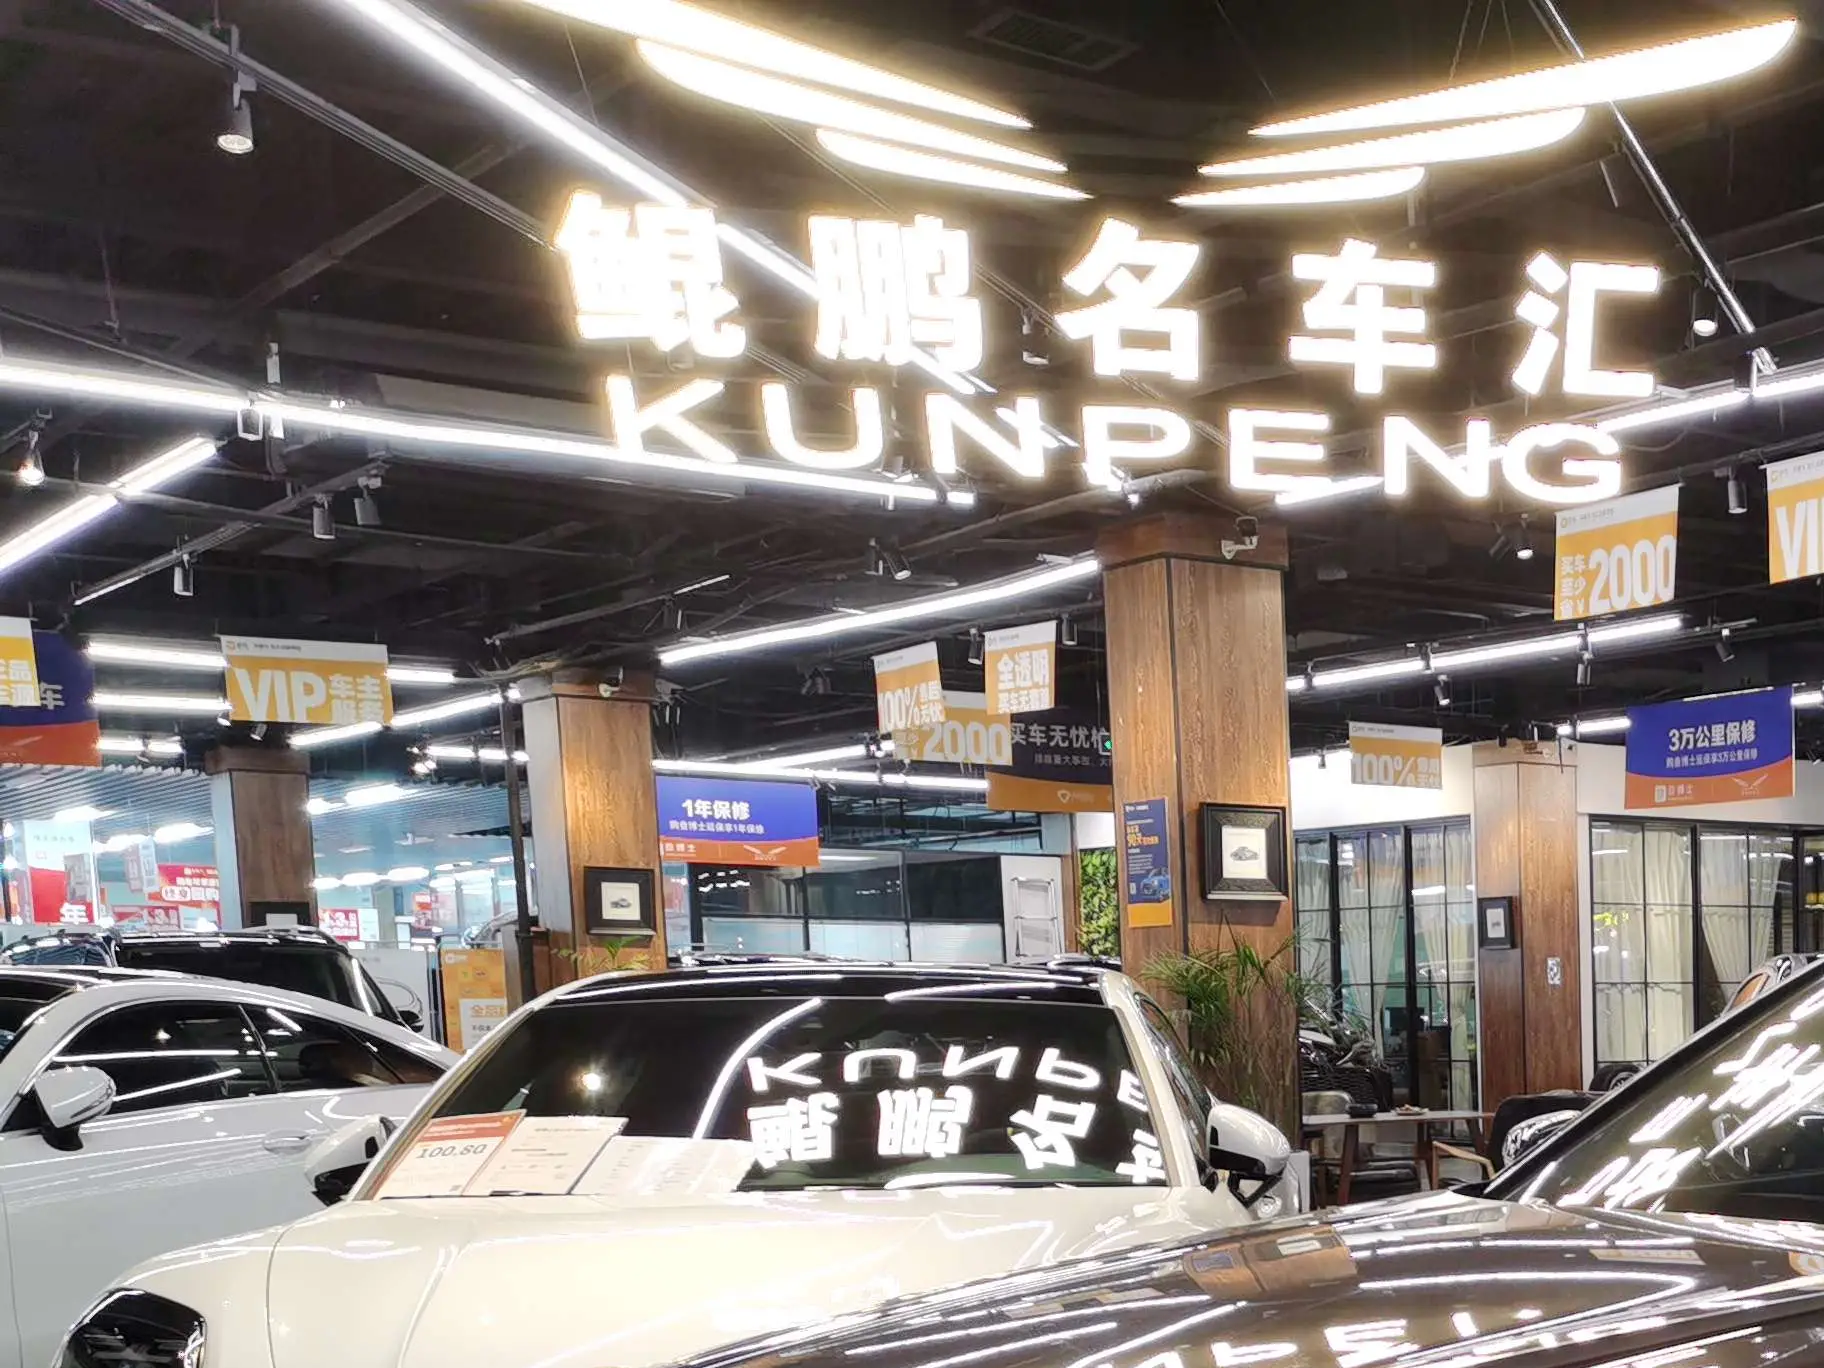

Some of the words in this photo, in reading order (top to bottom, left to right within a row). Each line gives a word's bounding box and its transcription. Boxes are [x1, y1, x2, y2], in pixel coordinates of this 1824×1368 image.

[554, 189, 1661, 399] 鲲鹏名车汇
[604, 373, 1626, 506] KUNPENG
[1588, 534, 1677, 616] 2000
[234, 667, 327, 722] VIP
[922, 719, 1010, 765] 2000
[1668, 719, 1757, 752] 3万公里保修
[682, 799, 750, 821] 1年保修
